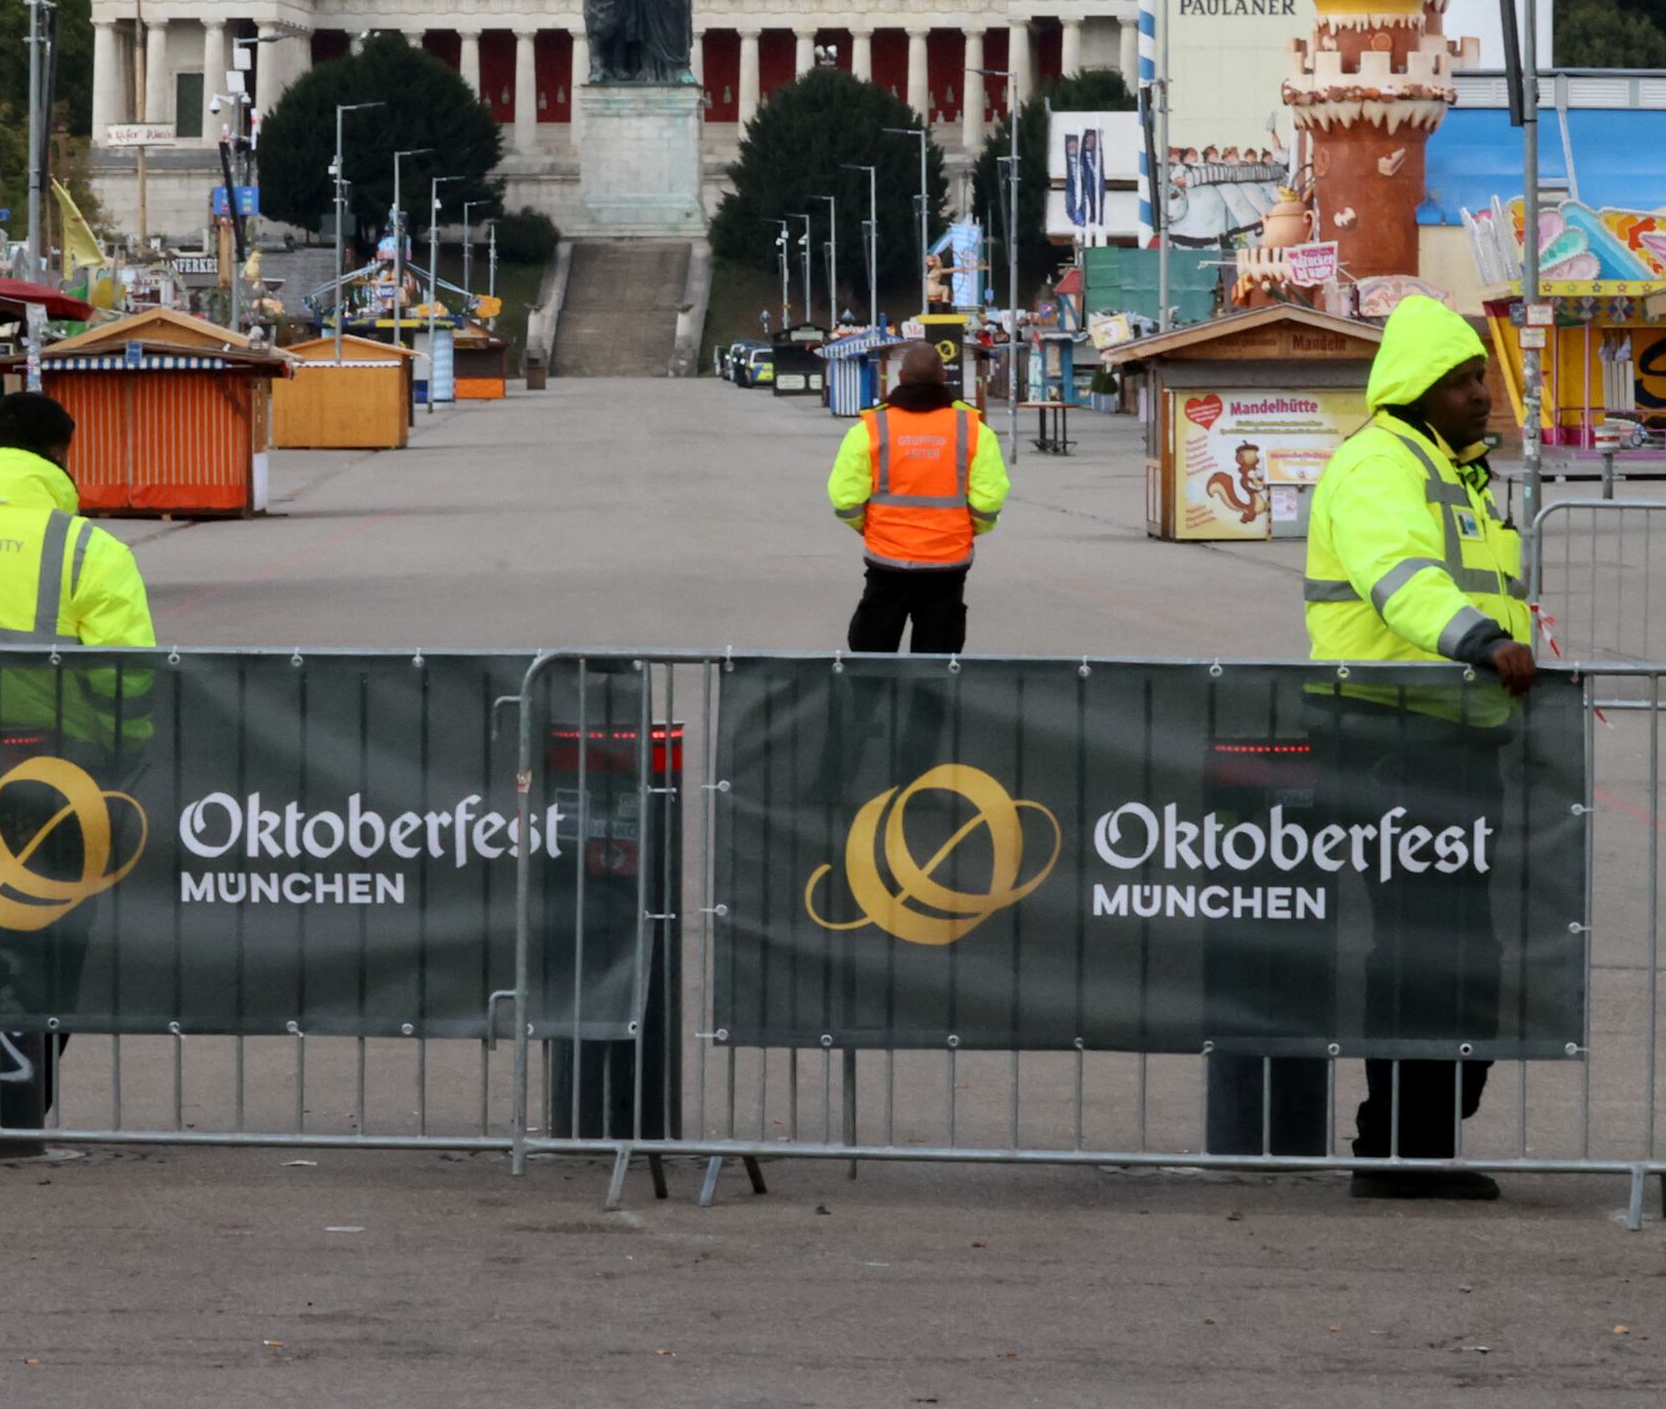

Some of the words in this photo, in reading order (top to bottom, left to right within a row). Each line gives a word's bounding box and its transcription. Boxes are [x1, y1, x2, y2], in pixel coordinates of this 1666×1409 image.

[1230, 398, 1318, 417] Mandelhütte
[179, 791, 566, 868] Oktoberfest
[1094, 801, 1494, 884] Oktoberfest
[181, 871, 406, 905] MÜNCHEN
[1093, 884, 1327, 920] MÜNCHEN
